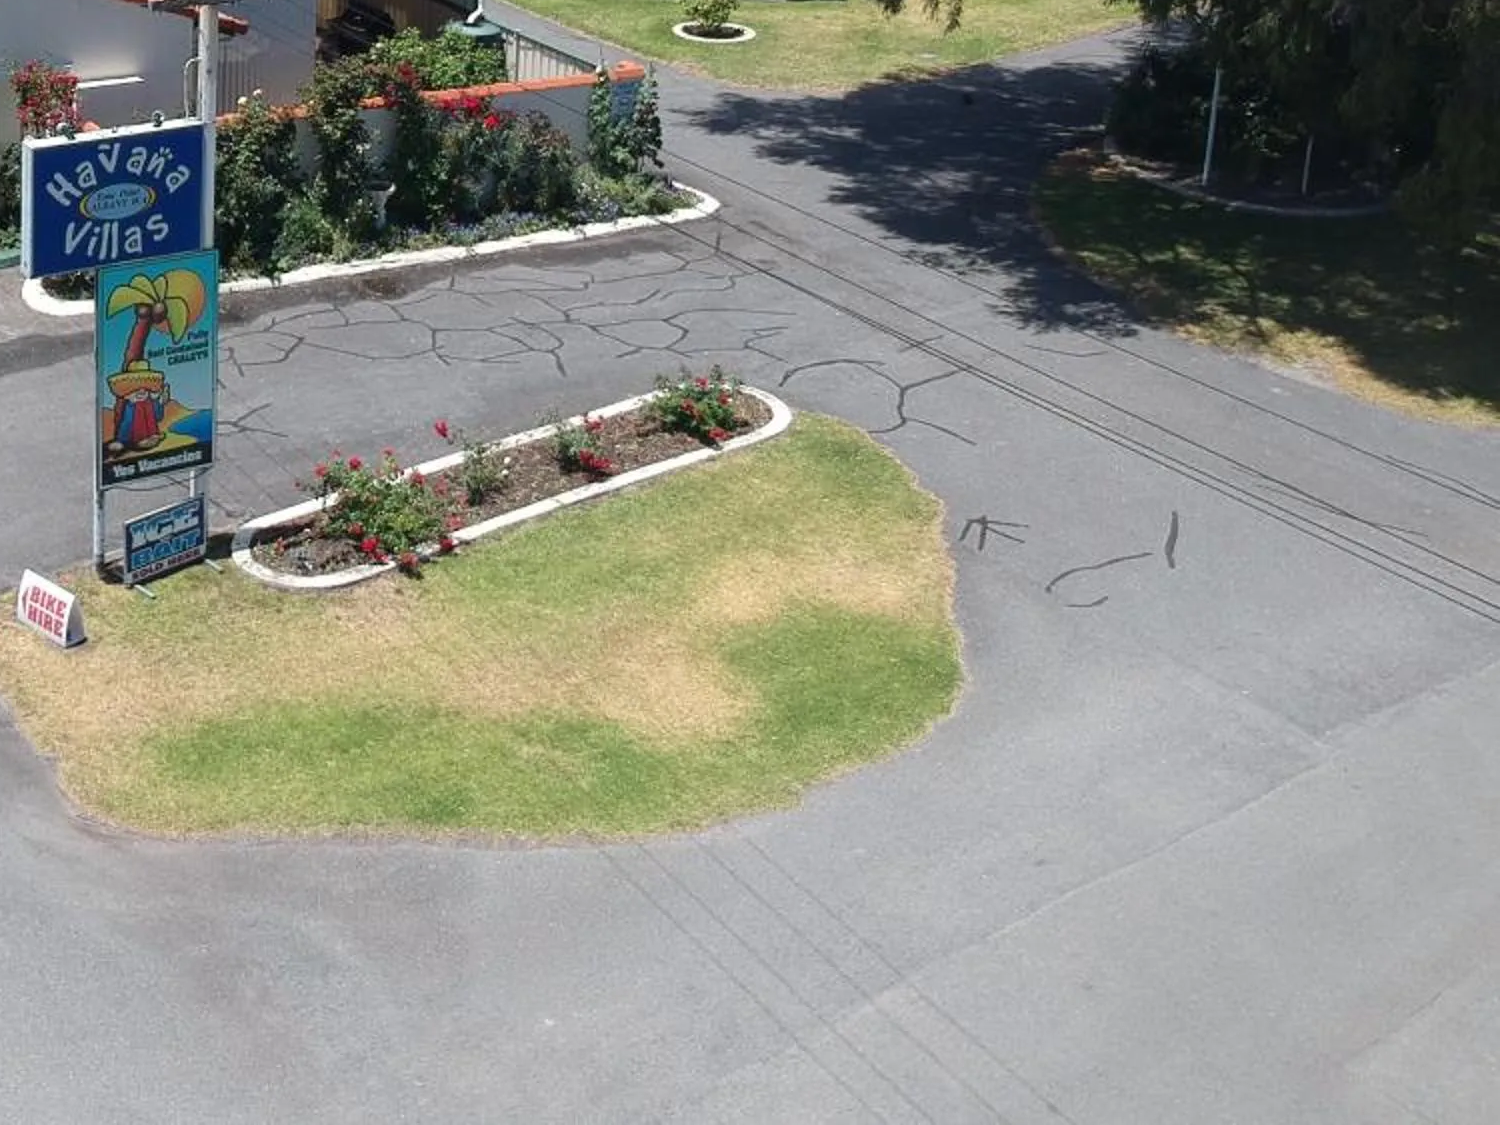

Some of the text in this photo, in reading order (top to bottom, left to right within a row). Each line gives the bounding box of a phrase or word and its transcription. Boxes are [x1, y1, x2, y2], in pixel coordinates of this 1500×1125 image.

[64, 214, 169, 260] Villas
[131, 528, 201, 570] BAIT
[132, 561, 165, 580] SOLD
[29, 585, 68, 620] BIKE
[27, 603, 64, 638] HIRE
